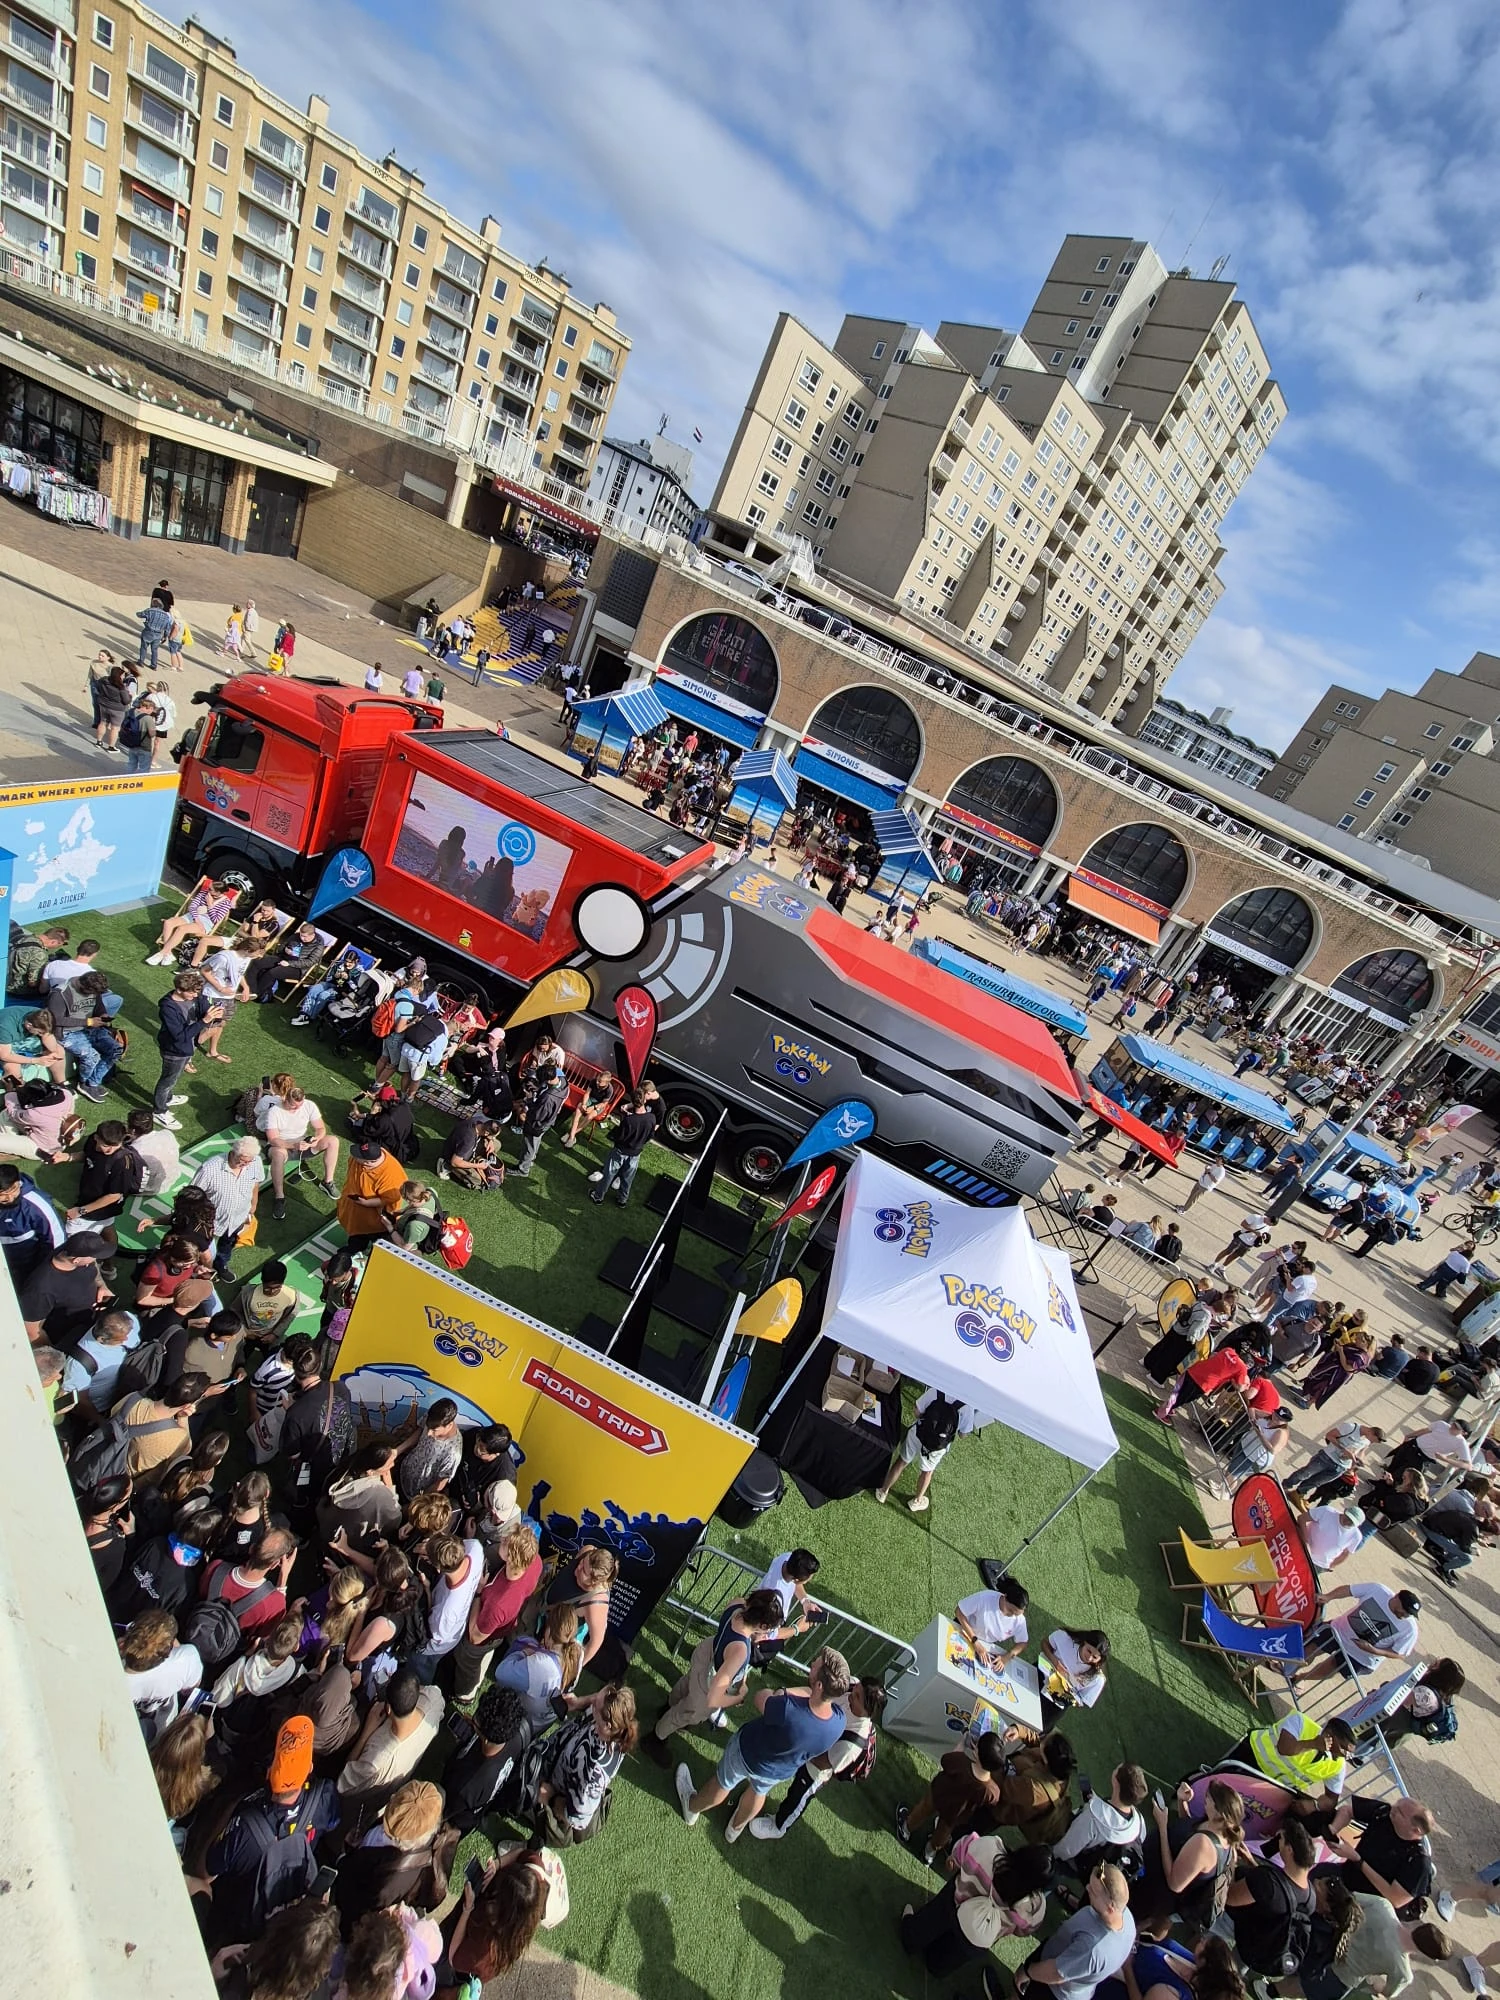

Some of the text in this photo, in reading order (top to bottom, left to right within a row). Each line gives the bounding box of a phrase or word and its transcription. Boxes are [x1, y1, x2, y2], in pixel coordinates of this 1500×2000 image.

[682, 679, 718, 701] SIMONIS
[826, 749, 861, 770] SIMONIS
[0, 781, 144, 802] MARK WHERE YOU'RE FROM
[205, 787, 228, 810] GO
[38, 900, 52, 910] ADD
[59, 891, 87, 905] STICKER!
[1214, 934, 1243, 953] ITALIAN
[1242, 947, 1258, 960] ICE
[1259, 956, 1288, 973] CREAM
[1370, 1009, 1402, 1030] TALIANO
[775, 1057, 812, 1084] GO
[873, 1207, 906, 1243] GO
[954, 1310, 1015, 1362] GO
[433, 1332, 484, 1368] GO
[532, 1368, 645, 1438] ROAD TRIP
[1248, 1505, 1263, 1530] GO
[1269, 1538, 1299, 1620] TEAM
[1276, 1530, 1309, 1612] PICK YOUR
[612, 1584, 638, 1600] ONDON
[615, 1578, 641, 1595] HESTER
[611, 1598, 630, 1611] ENCIA
[615, 1591, 634, 1606] PARIS
